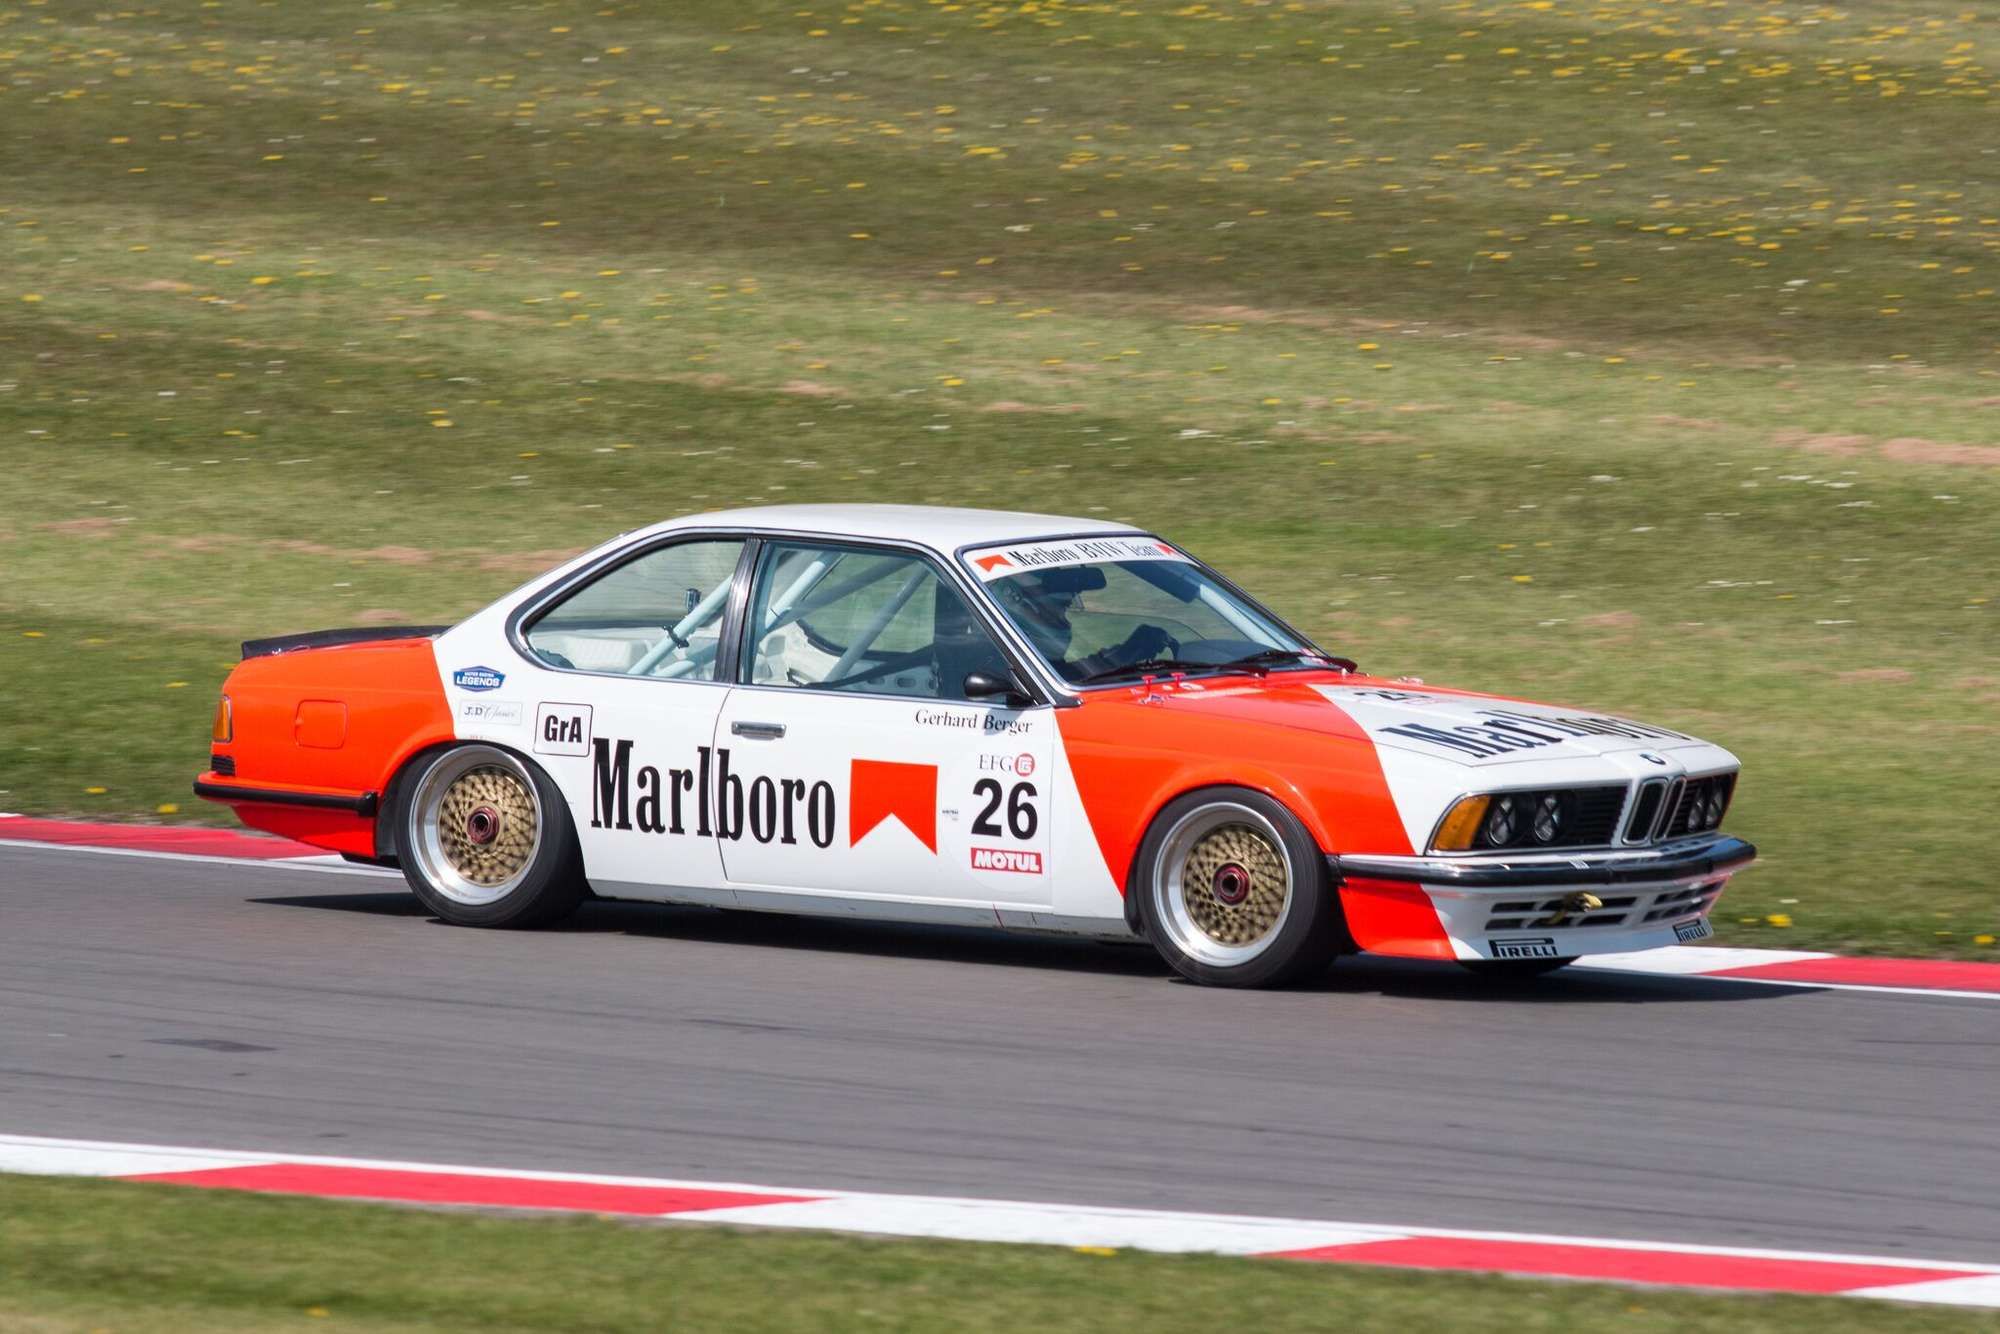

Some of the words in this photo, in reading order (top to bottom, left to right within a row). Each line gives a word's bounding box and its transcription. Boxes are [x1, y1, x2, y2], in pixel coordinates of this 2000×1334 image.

[1007, 546, 1080, 567] Marlboro
[456, 675, 500, 687] LEGENDS
[544, 715, 582, 744] GrA
[915, 709, 978, 729] Gerhard
[983, 714, 1033, 736] Berger
[978, 753, 1013, 772] EFG
[591, 737, 836, 849] Marlboro
[971, 778, 1039, 841] 26
[974, 850, 1040, 872] MOTUL
[1672, 917, 1709, 944] PIRELLI
[1488, 937, 1558, 957] PIRELLI
